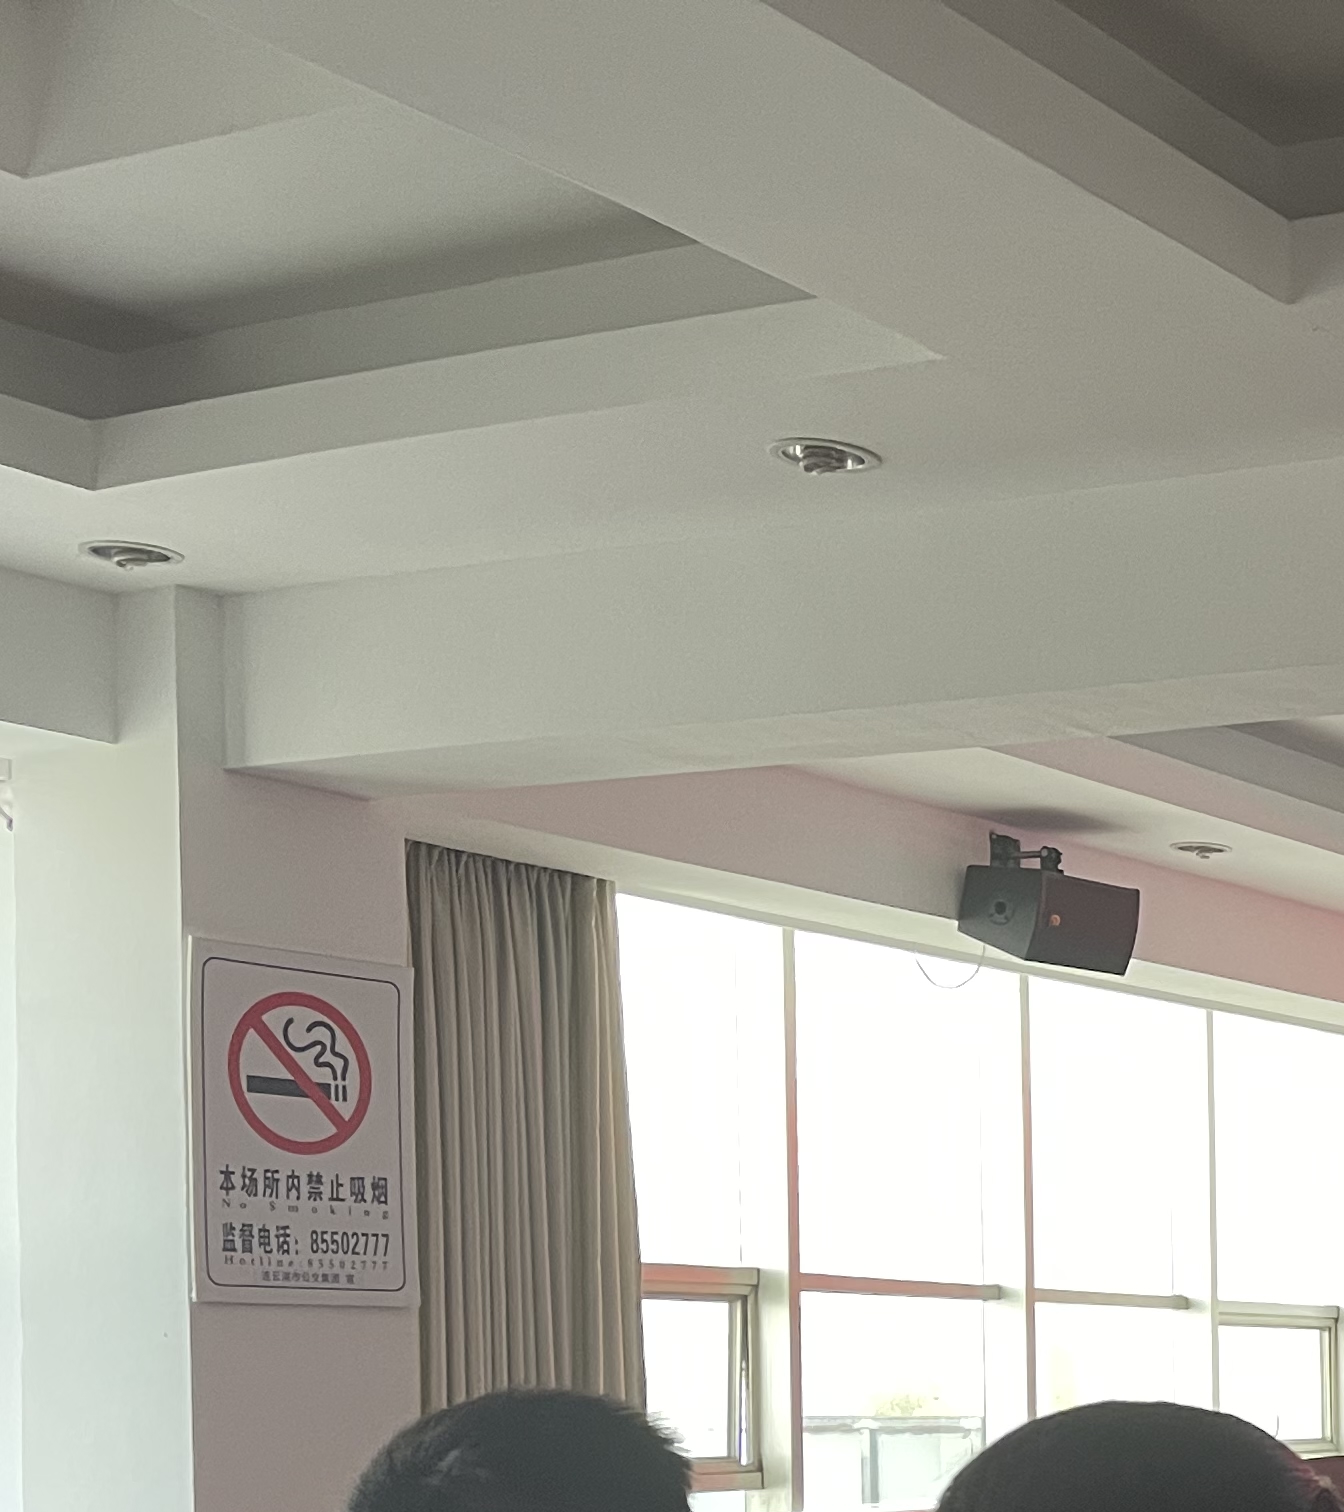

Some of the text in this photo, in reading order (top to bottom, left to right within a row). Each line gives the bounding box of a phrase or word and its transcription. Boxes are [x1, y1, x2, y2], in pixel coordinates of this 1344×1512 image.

[219, 1164, 389, 1206] 本场所内禁止吸烟
[222, 1198, 248, 1209] No
